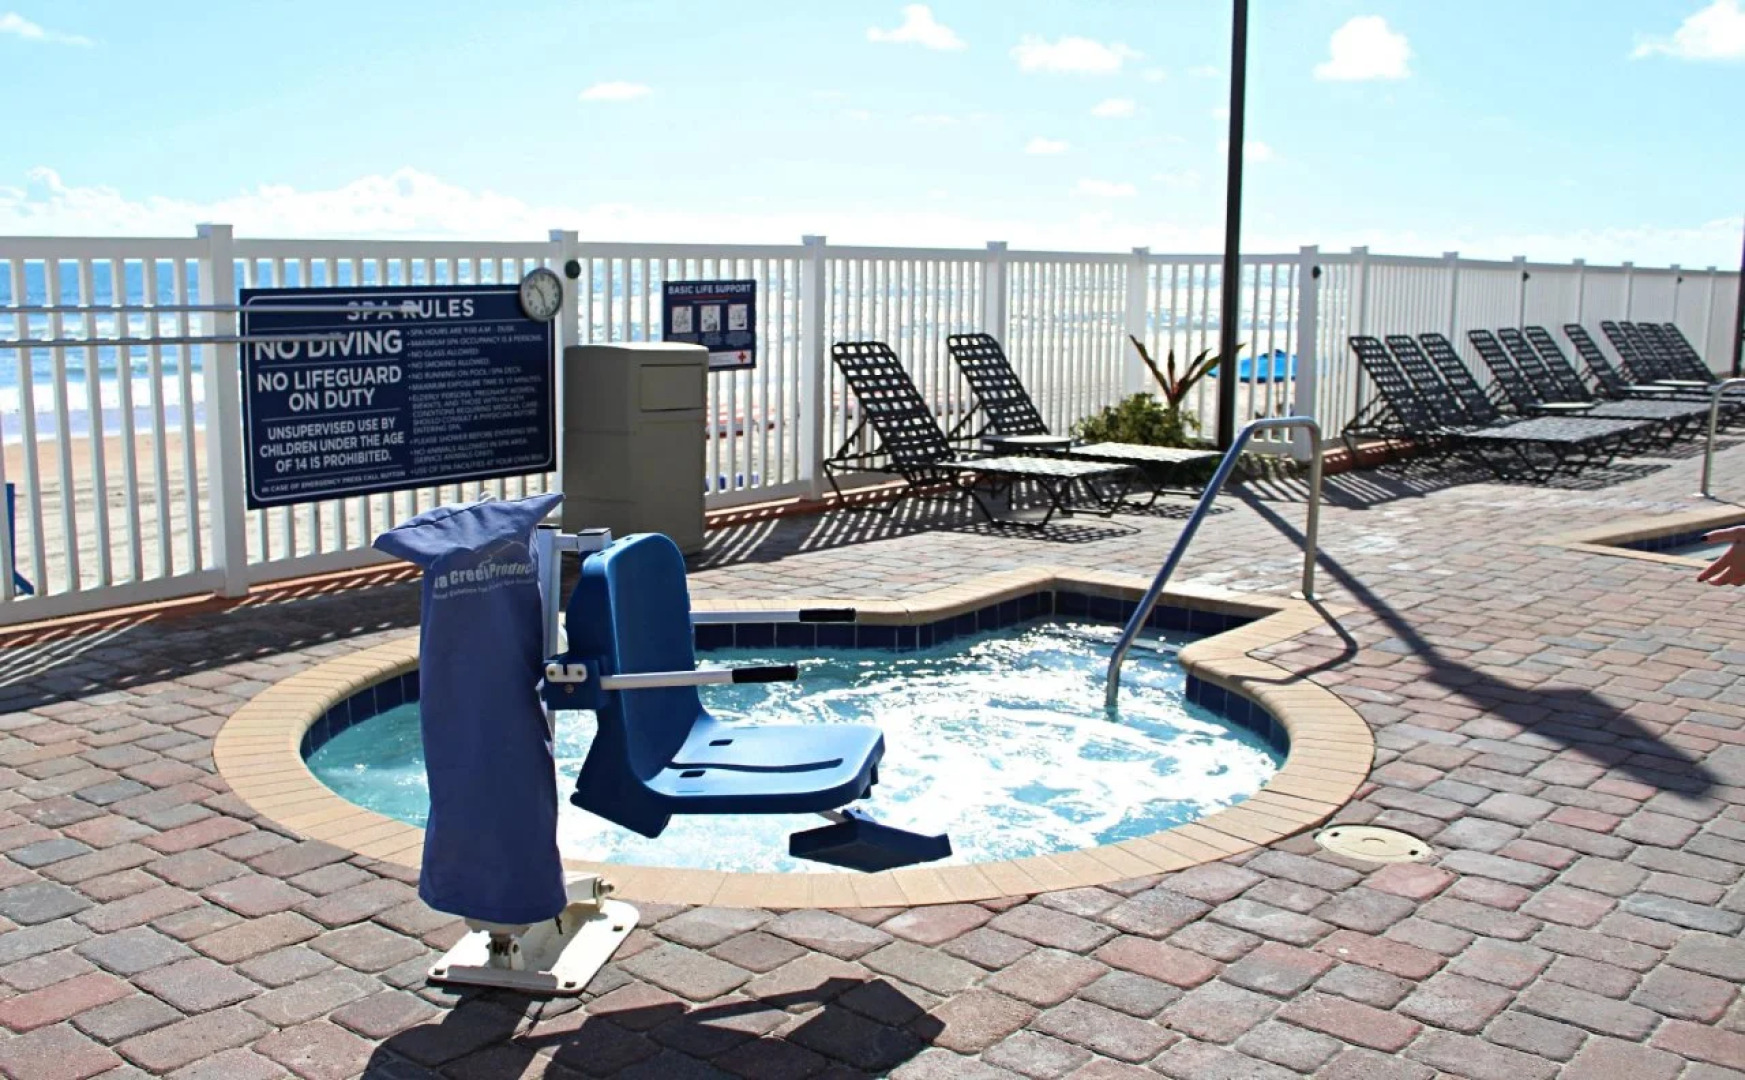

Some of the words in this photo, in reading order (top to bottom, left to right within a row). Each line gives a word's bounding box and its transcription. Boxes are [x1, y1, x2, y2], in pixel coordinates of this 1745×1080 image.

[668, 285, 694, 294] BASIC
[695, 285, 713, 294] LIFE
[715, 284, 751, 293] SUPPORT
[347, 301, 394, 320] SPA
[402, 299, 475, 319] RULES
[254, 336, 299, 360] NO
[307, 330, 403, 358] DIVING
[258, 372, 289, 392] NO
[294, 366, 402, 390] LIFEGUARD
[288, 392, 319, 412] ON
[325, 387, 375, 409] DUTY
[268, 421, 355, 440] UNSUPERVISED
[357, 418, 378, 431] USE
[381, 417, 395, 430] BY
[260, 442, 317, 458] CHILDREN
[319, 438, 357, 452] UNDER
[360, 435, 380, 447] THE
[383, 432, 404, 444] AGE
[275, 459, 292, 473] OF
[295, 458, 307, 470] 14
[310, 457, 321, 469] IS
[324, 450, 392, 467] PROHIBITED.
